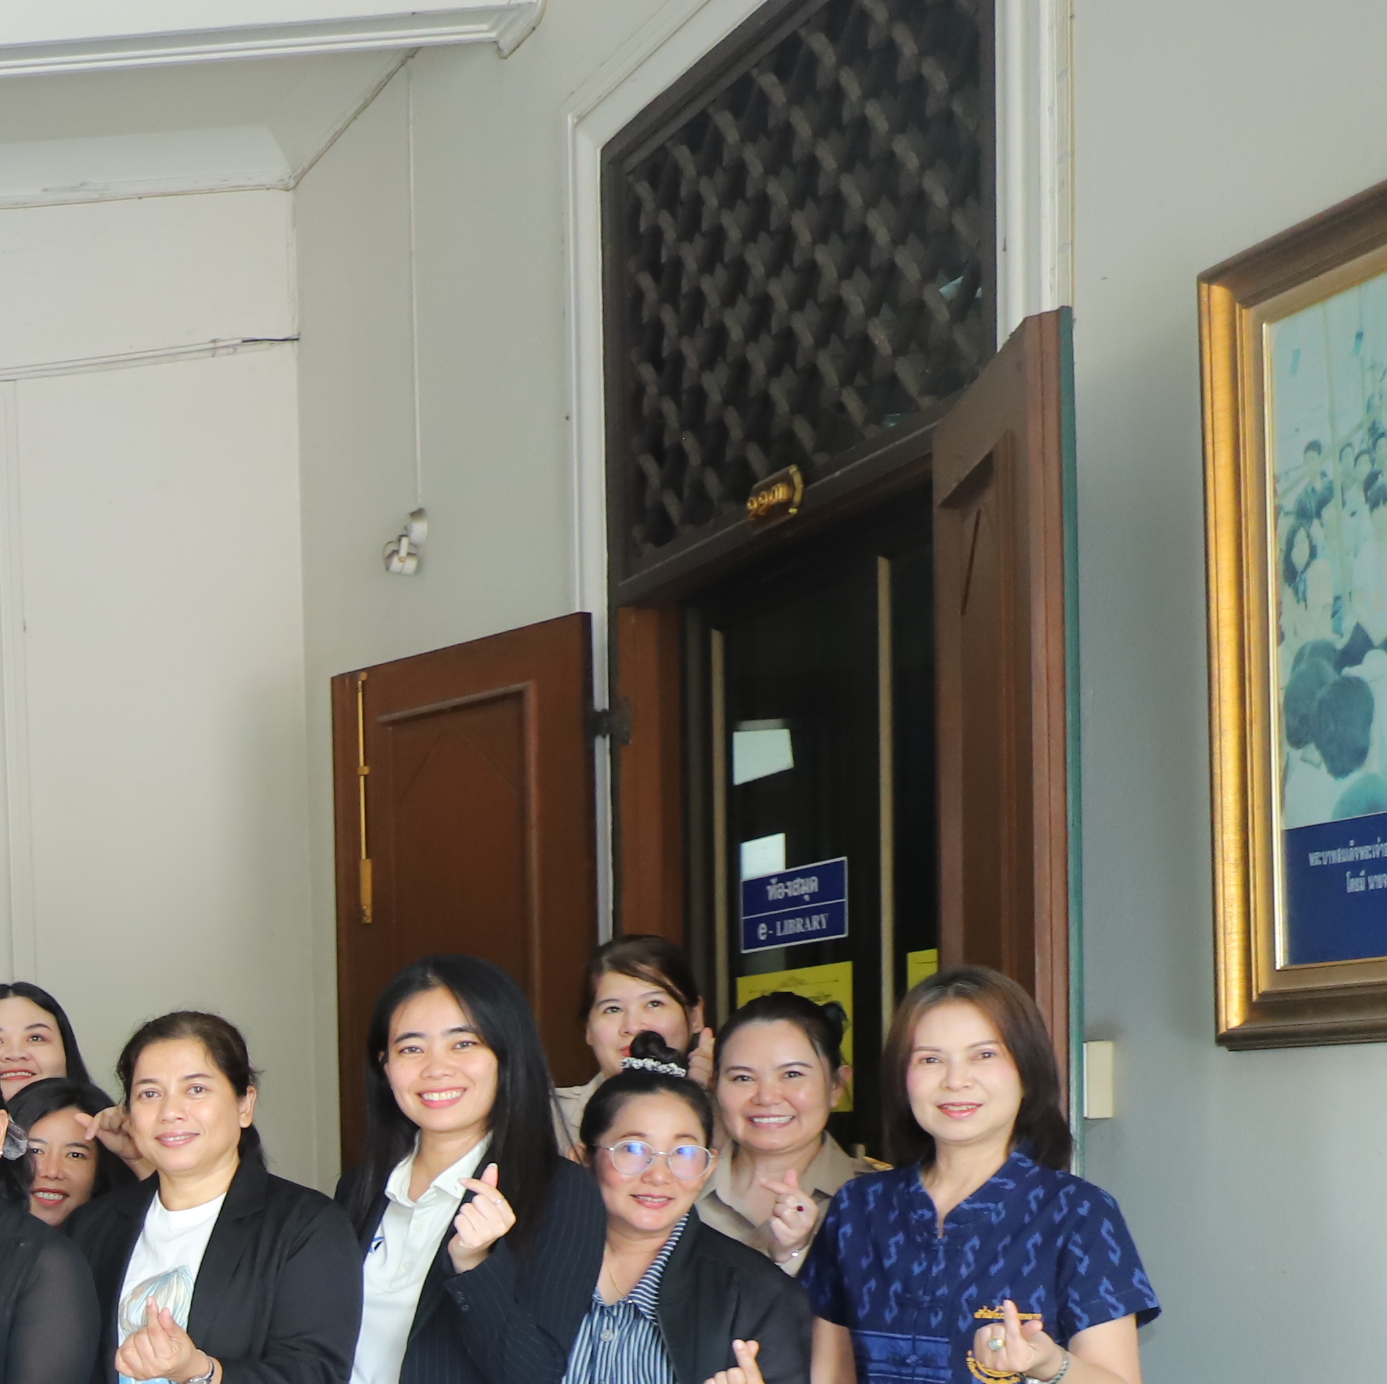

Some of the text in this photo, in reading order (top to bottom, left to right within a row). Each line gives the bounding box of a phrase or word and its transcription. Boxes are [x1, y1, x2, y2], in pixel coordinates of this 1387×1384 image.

[767, 876, 819, 902] ห้องสมุด
[776, 913, 829, 936] LIBRARY
